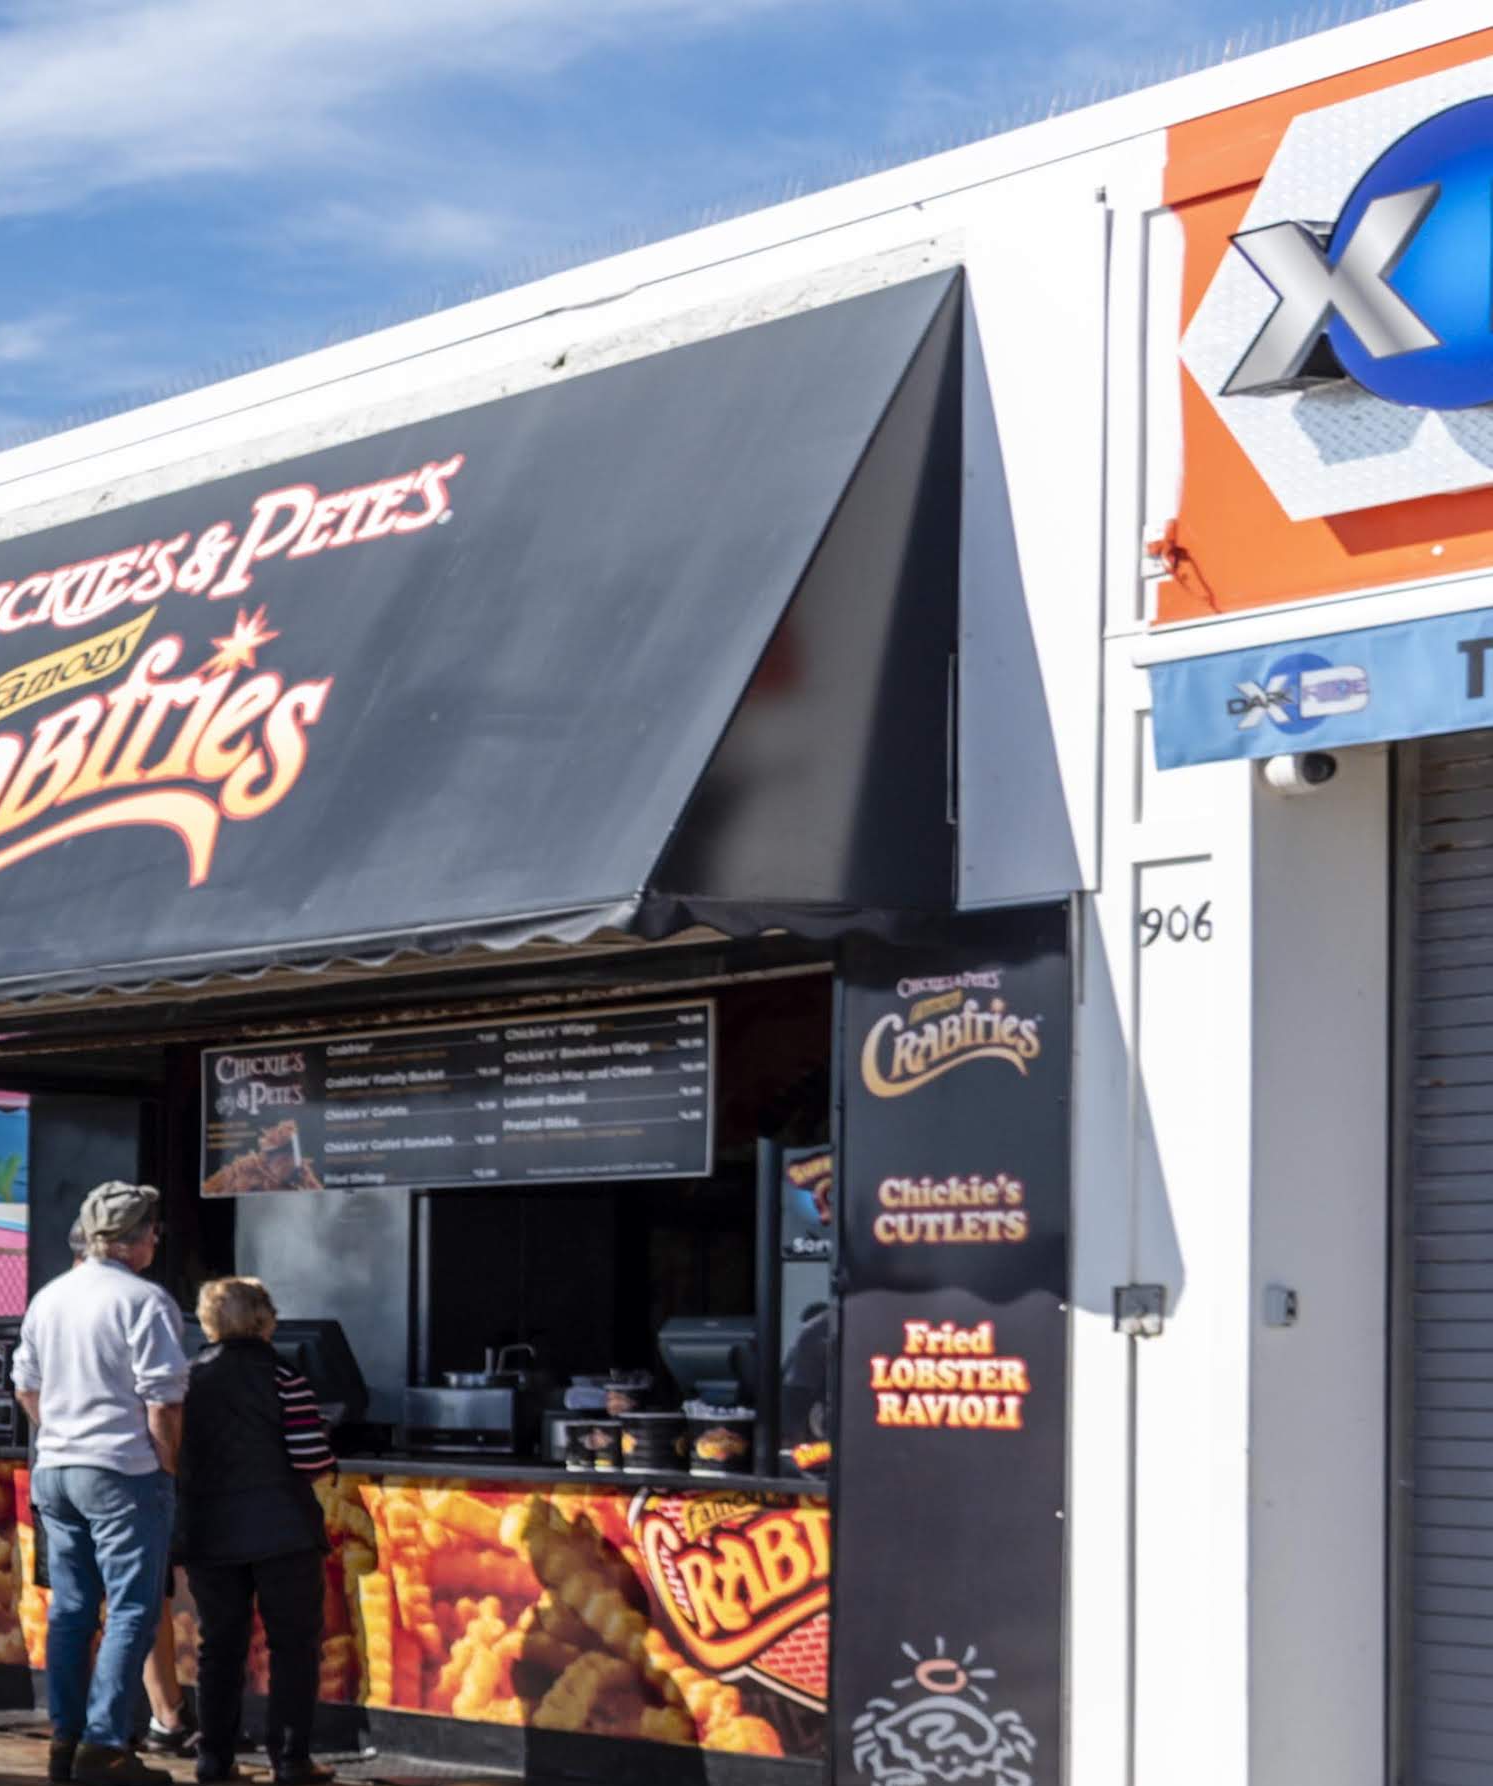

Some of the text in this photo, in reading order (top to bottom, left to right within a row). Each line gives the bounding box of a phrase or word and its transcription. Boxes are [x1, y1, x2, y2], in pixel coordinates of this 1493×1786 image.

[209, 453, 464, 601] PETE'S
[1138, 901, 1214, 948] 906
[216, 1051, 305, 1084] CHICKIE'S
[878, 1173, 1023, 1207] Chickie's
[874, 1208, 1027, 1243] CUTLETS
[904, 1320, 993, 1355] Fried
[870, 1356, 1029, 1393] LOBSTER
[875, 1392, 1023, 1429] RAVIOLI
